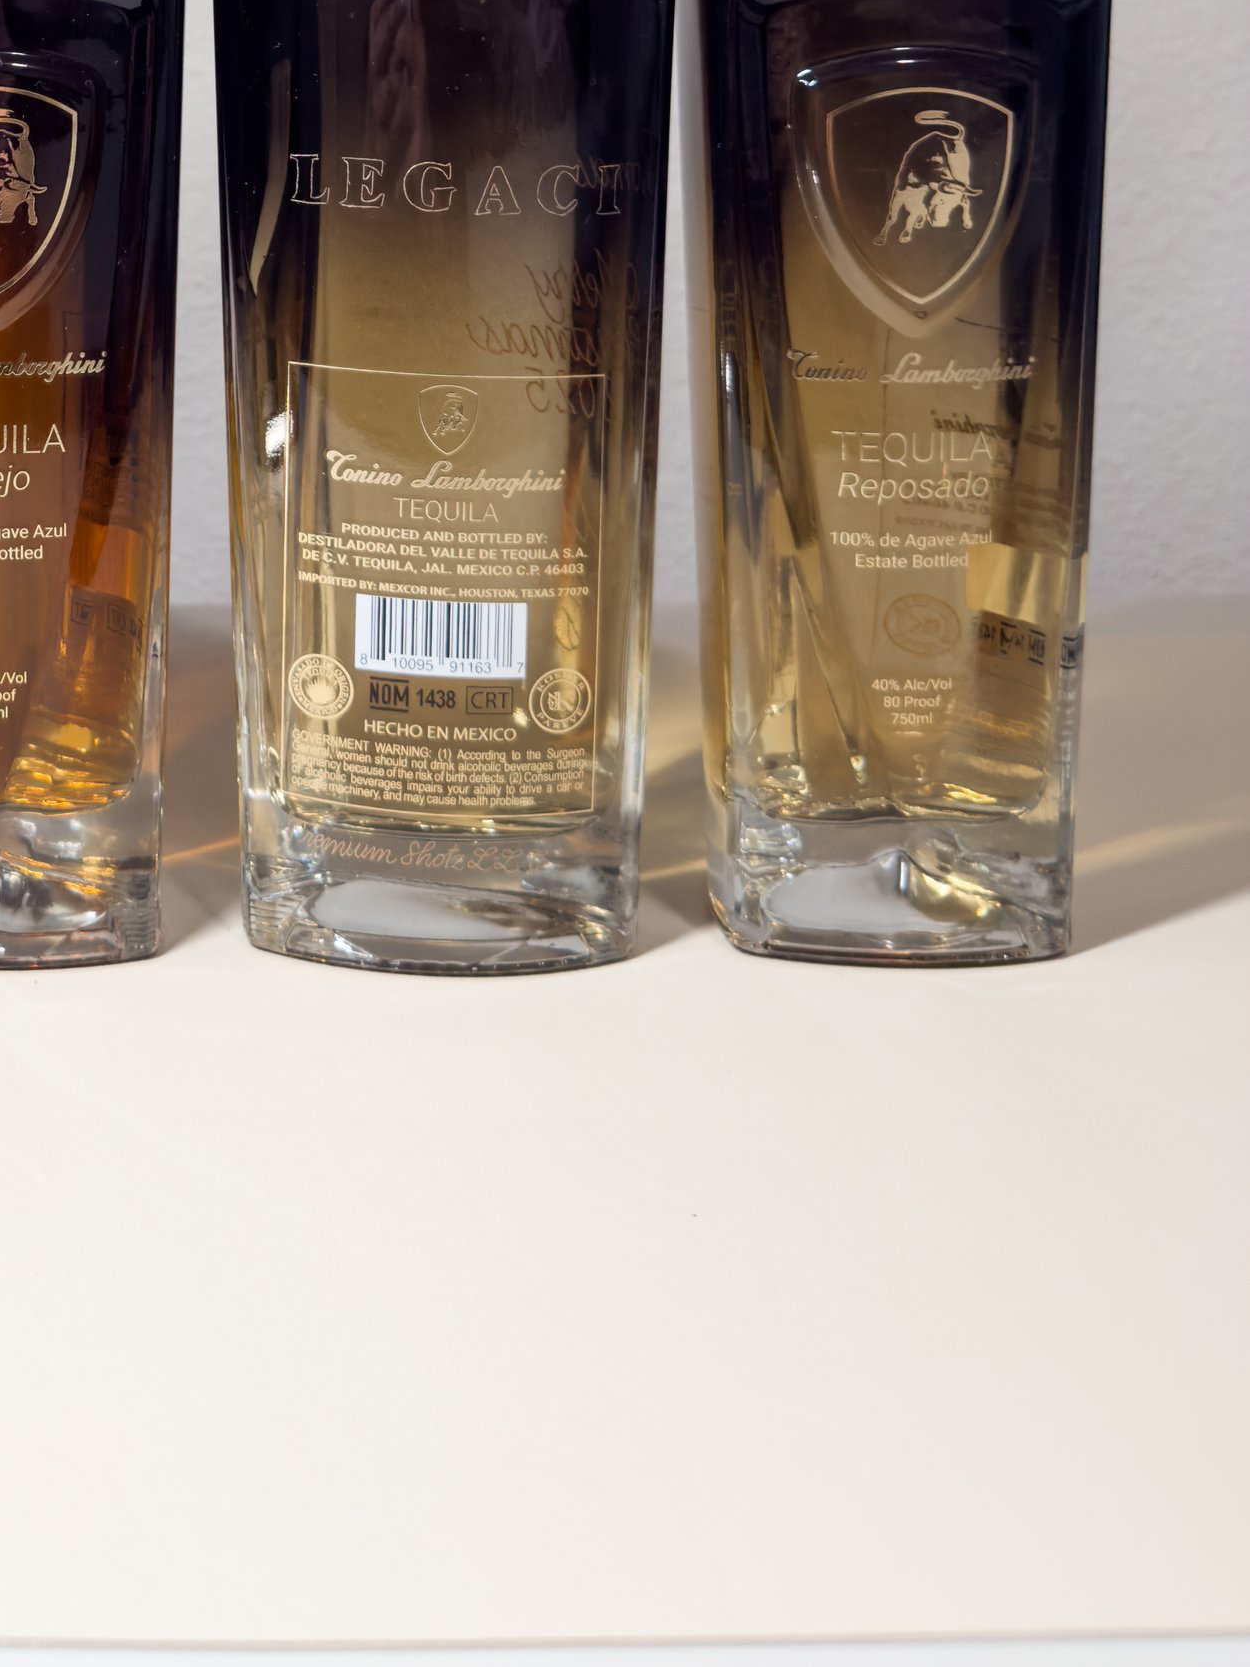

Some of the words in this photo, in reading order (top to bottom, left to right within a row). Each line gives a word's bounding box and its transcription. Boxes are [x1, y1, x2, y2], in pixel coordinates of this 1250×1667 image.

[787, 347, 868, 382] Tonino
[878, 352, 1036, 391] Lamborghini
[831, 430, 993, 467] TEQUILA
[326, 449, 403, 486] Tonino
[409, 460, 566, 498] Lamborghini
[838, 470, 990, 505] Reposado
[393, 497, 498, 523] TEQUILA
[33, 522, 67, 538] Azul
[342, 523, 419, 540] PRODUCED
[423, 531, 454, 542] AND
[458, 532, 521, 544] BOTTLED
[525, 533, 548, 544] BY:
[830, 531, 875, 546] 100%
[880, 532, 901, 547] de
[905, 533, 956, 550] Agave
[959, 529, 992, 544] Azul
[298, 532, 396, 554] DESTILADORA
[400, 544, 427, 556] DEL
[431, 546, 476, 559] VALLE
[479, 548, 497, 559] DE
[501, 549, 559, 561] TEQUILA
[563, 547, 588, 559] S.A.
[302, 548, 320, 561] DE
[323, 551, 349, 565] C.V.
[353, 555, 418, 575] TEQUILA,
[421, 562, 452, 574] JAL.
[456, 564, 512, 576] MEXICO
[516, 564, 540, 575] C.P.
[544, 563, 584, 575] 46403
[854, 553, 908, 568] Estate
[912, 552, 969, 568] Bottled
[298, 571, 355, 589] IMPORTED
[358, 580, 378, 591] BY:
[379, 582, 428, 595] MEXCOR
[459, 587, 518, 599] HOUSTON,
[521, 587, 555, 598] TEXAS
[558, 585, 589, 596] 77070
[360, 653, 368, 665] 8
[393, 657, 434, 671] 10095
[450, 661, 492, 674] 91163
[517, 662, 524, 673] 7
[369, 682, 409, 707] NOM
[416, 688, 456, 709] 1438
[470, 691, 510, 709] CRT
[871, 678, 900, 691] 40%
[903, 677, 953, 692] Alc/Vol
[883, 695, 900, 707] 80
[904, 694, 941, 708] Proof
[364, 719, 423, 737] HECHO
[427, 725, 448, 740] EN
[453, 727, 518, 742] MEXICO
[891, 712, 933, 724] 750ml
[292, 728, 369, 751] GOVERNMENT
[374, 741, 431, 758] WARNING:
[438, 747, 452, 760] (1)
[457, 749, 506, 763] According
[511, 749, 521, 759] to
[526, 749, 541, 759] the
[546, 747, 585, 760] Surgeon
[400, 839, 466, 869] Shotz
